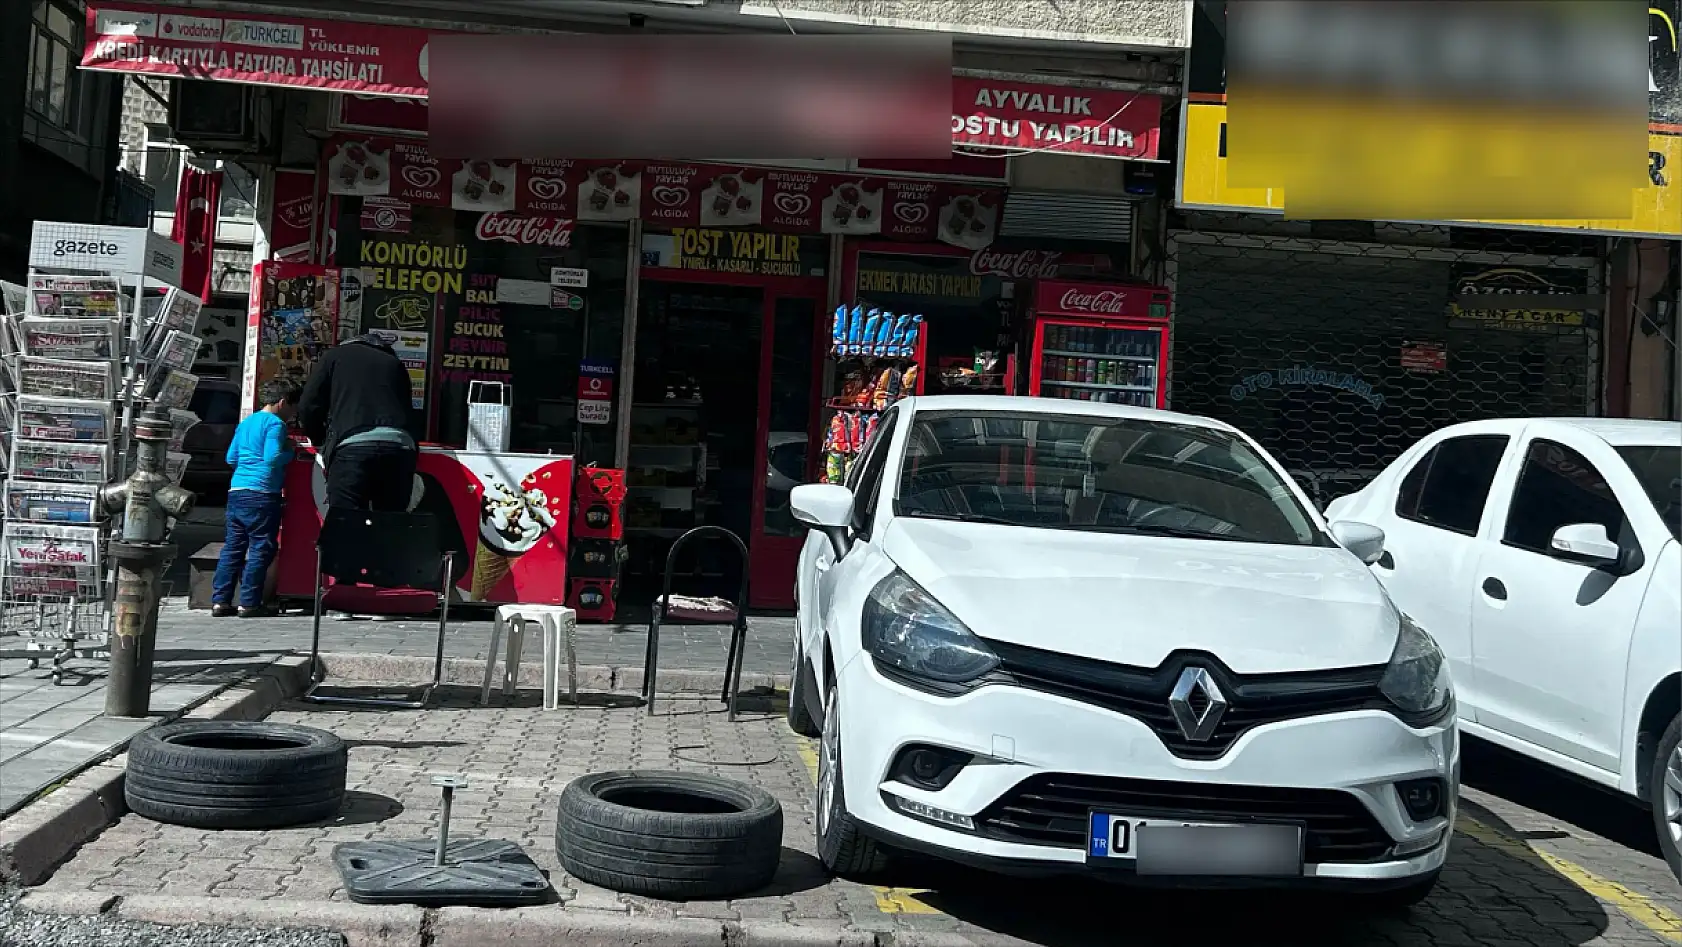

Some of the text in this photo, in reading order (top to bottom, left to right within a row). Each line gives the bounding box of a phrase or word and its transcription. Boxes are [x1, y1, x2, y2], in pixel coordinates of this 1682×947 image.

[178, 22, 220, 37] vodafone
[244, 25, 300, 45] TURKCELL
[310, 28, 326, 37] TL
[309, 40, 380, 56] YÜKLENİR
[94, 40, 383, 84] KREDİ KARTIYLA FATURA TAHSİLATI
[975, 88, 1092, 116] AYVALIK
[1028, 120, 1135, 149] YAPILIR
[401, 188, 441, 200] ALGIDA
[528, 202, 567, 212] ALGIDA
[651, 208, 690, 218] ALGIDA
[772, 215, 811, 226] ALGIDA
[53, 239, 119, 257] gazete
[671, 227, 725, 259] TOST
[729, 232, 800, 262] YAPILIR
[360, 240, 468, 270] KONTÖRLÜ
[360, 265, 464, 295] TELEFON
[858, 269, 900, 293] EKMEK
[902, 271, 937, 295] ARASI
[466, 289, 499, 304] BAL
[1059, 289, 1128, 314] Coca-Cola
[453, 321, 505, 338] SUCUK
[442, 353, 511, 371] ZEYTİN
[1230, 371, 1272, 401] OTO
[17, 547, 47, 561] Yeni
[1093, 837, 1108, 849] TR
